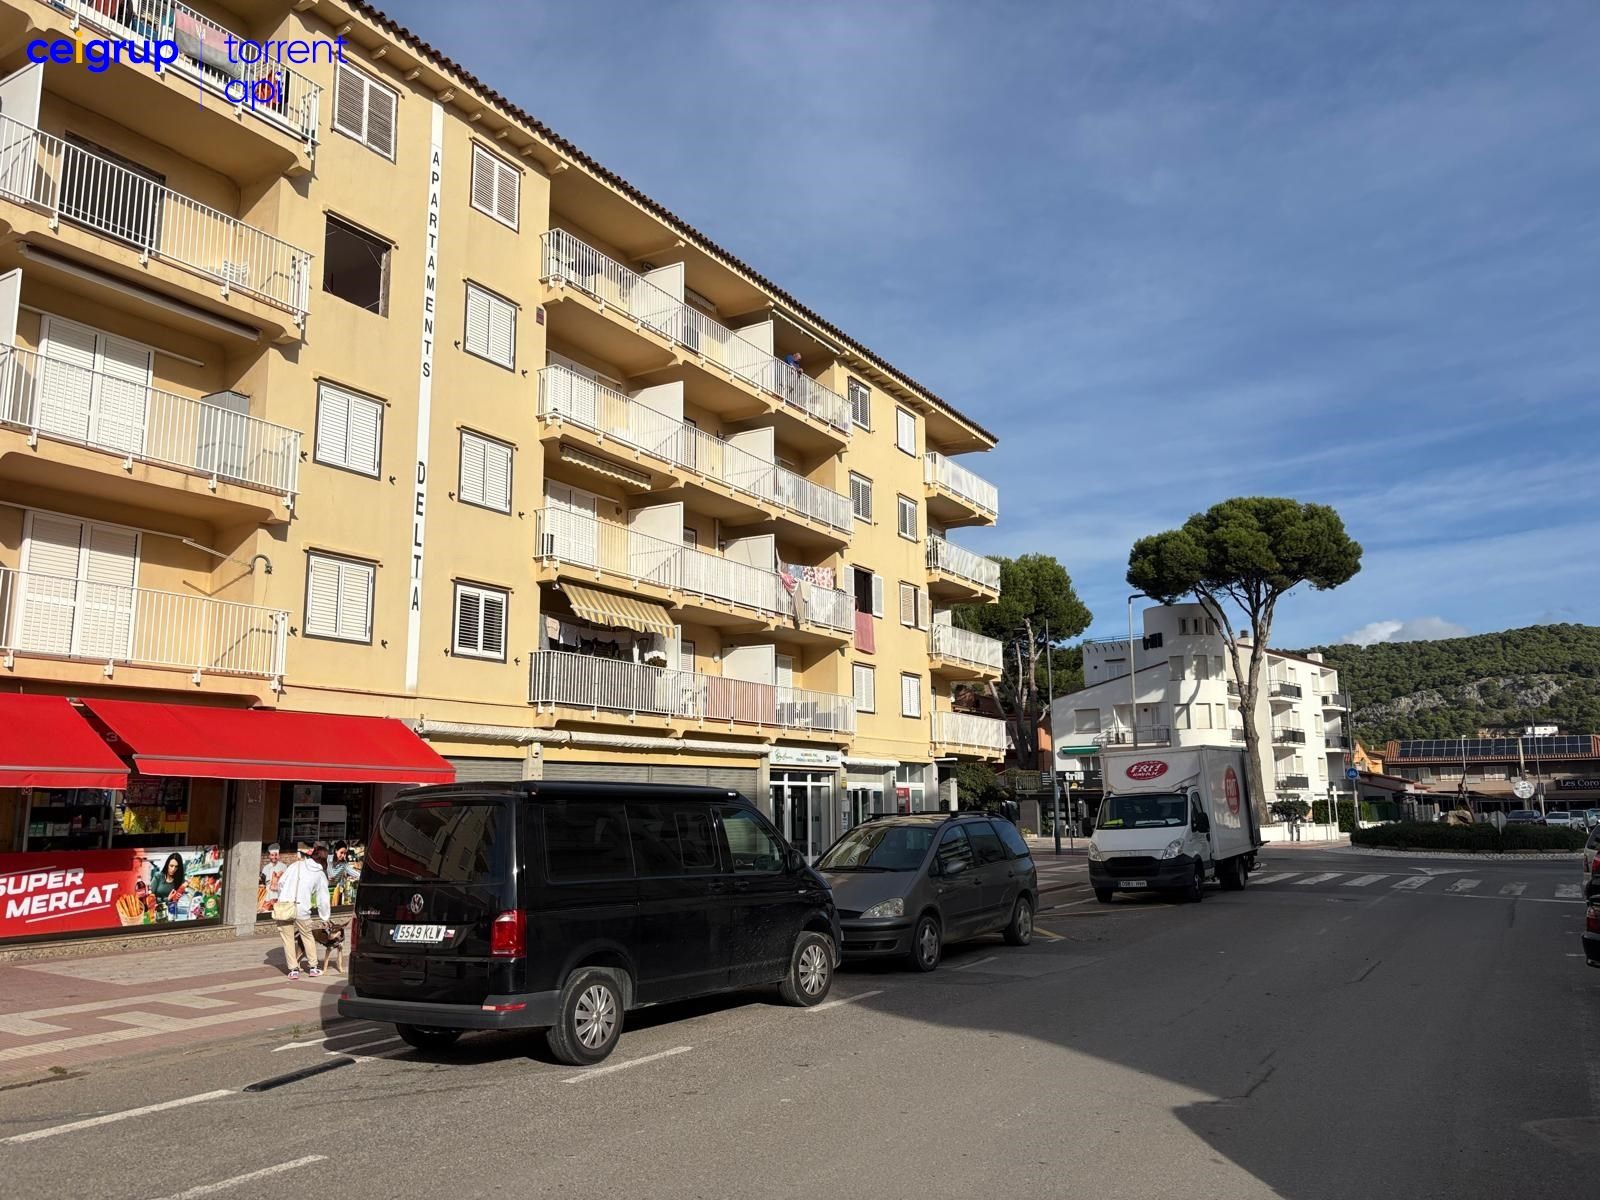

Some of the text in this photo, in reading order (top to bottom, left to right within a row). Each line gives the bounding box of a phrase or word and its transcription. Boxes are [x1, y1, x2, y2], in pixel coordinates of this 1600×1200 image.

[411, 151, 440, 612] APARTAMENTS DELTA
[1131, 763, 1163, 773] FRIT
[1560, 779, 1576, 787] Les
[5, 883, 119, 919] MERCAT
